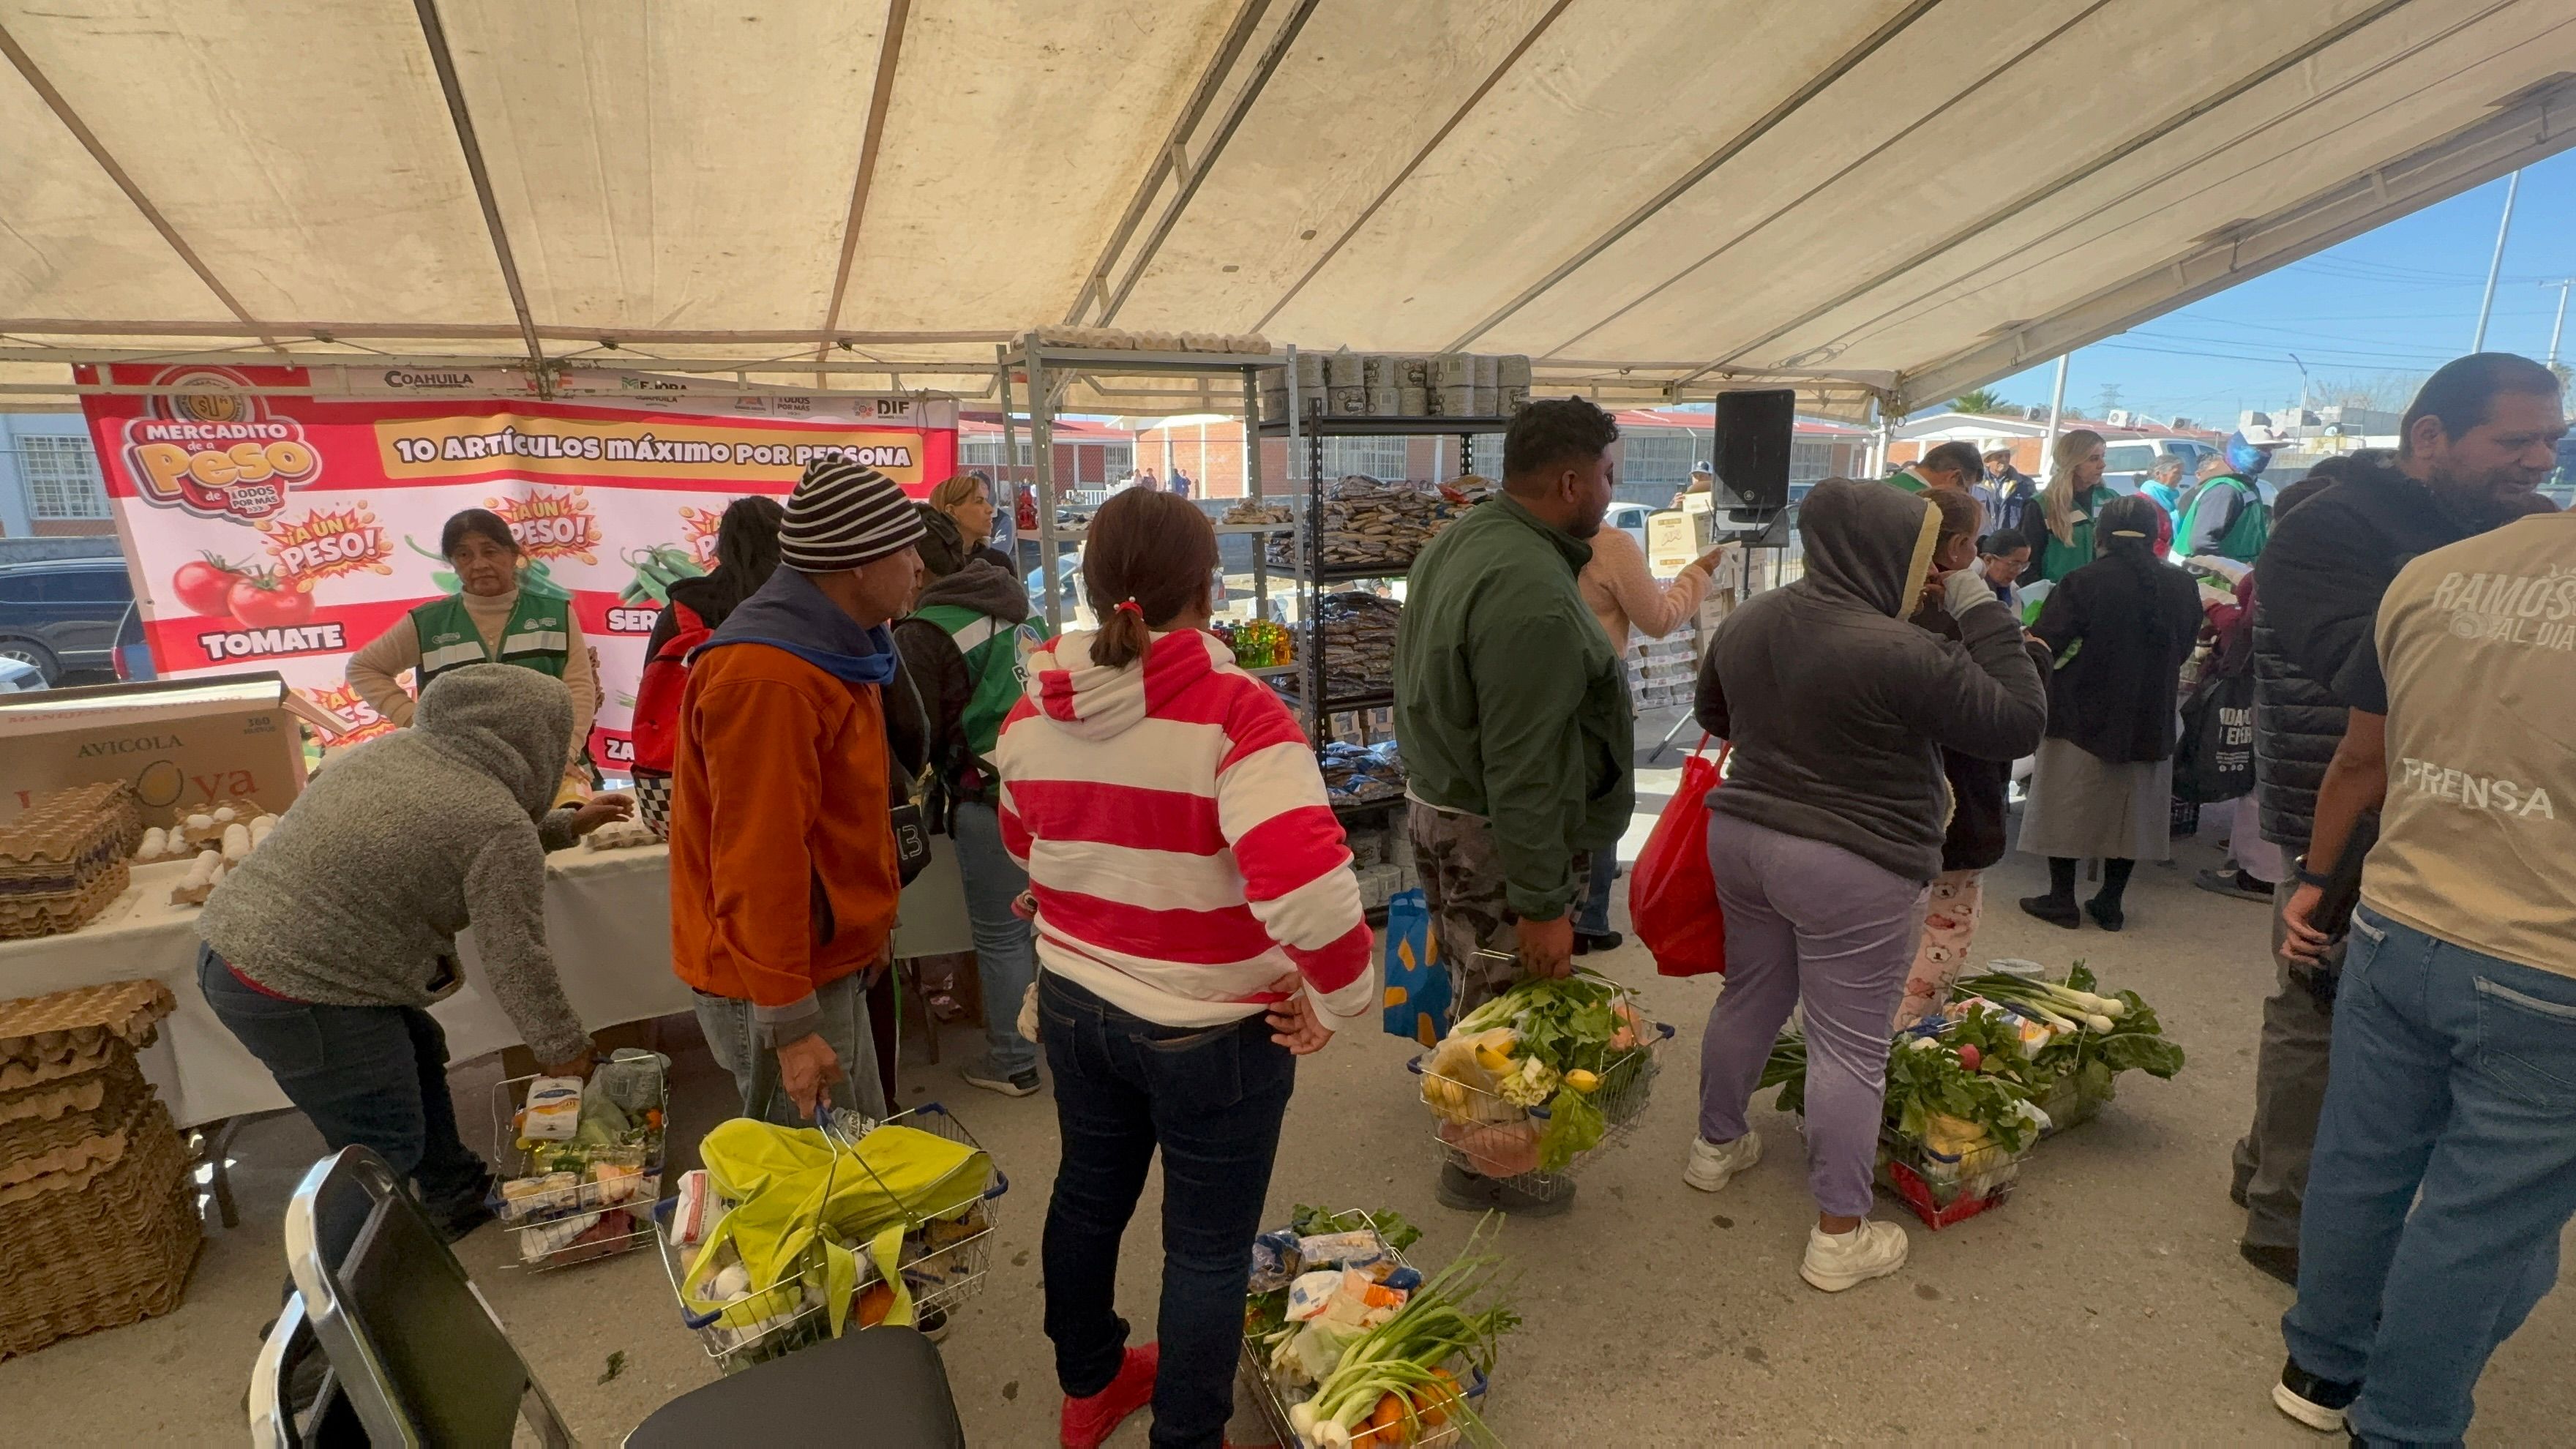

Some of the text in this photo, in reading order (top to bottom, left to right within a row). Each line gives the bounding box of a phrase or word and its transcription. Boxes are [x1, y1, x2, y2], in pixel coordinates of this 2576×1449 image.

[384, 371, 473, 387] COAHUILA
[877, 400, 909, 414] DIF
[146, 424, 288, 440] MERCADITO
[187, 441, 203, 452] de
[394, 438, 438, 463] 10
[442, 427, 601, 460] ARTÍCULOS
[607, 434, 730, 462] MÁXIMO
[735, 443, 791, 464] POR
[206, 491, 222, 501] de
[233, 499, 253, 507] POR
[532, 501, 558, 518] UN
[312, 517, 344, 537] UN
[280, 530, 375, 574] PESO!
[2431, 572, 2576, 620] RAMOS
[2492, 618, 2528, 643] AL
[201, 624, 345, 659] TOMATE
[78, 734, 184, 758] AVICOLA
[2403, 757, 2553, 819] PRENSA
